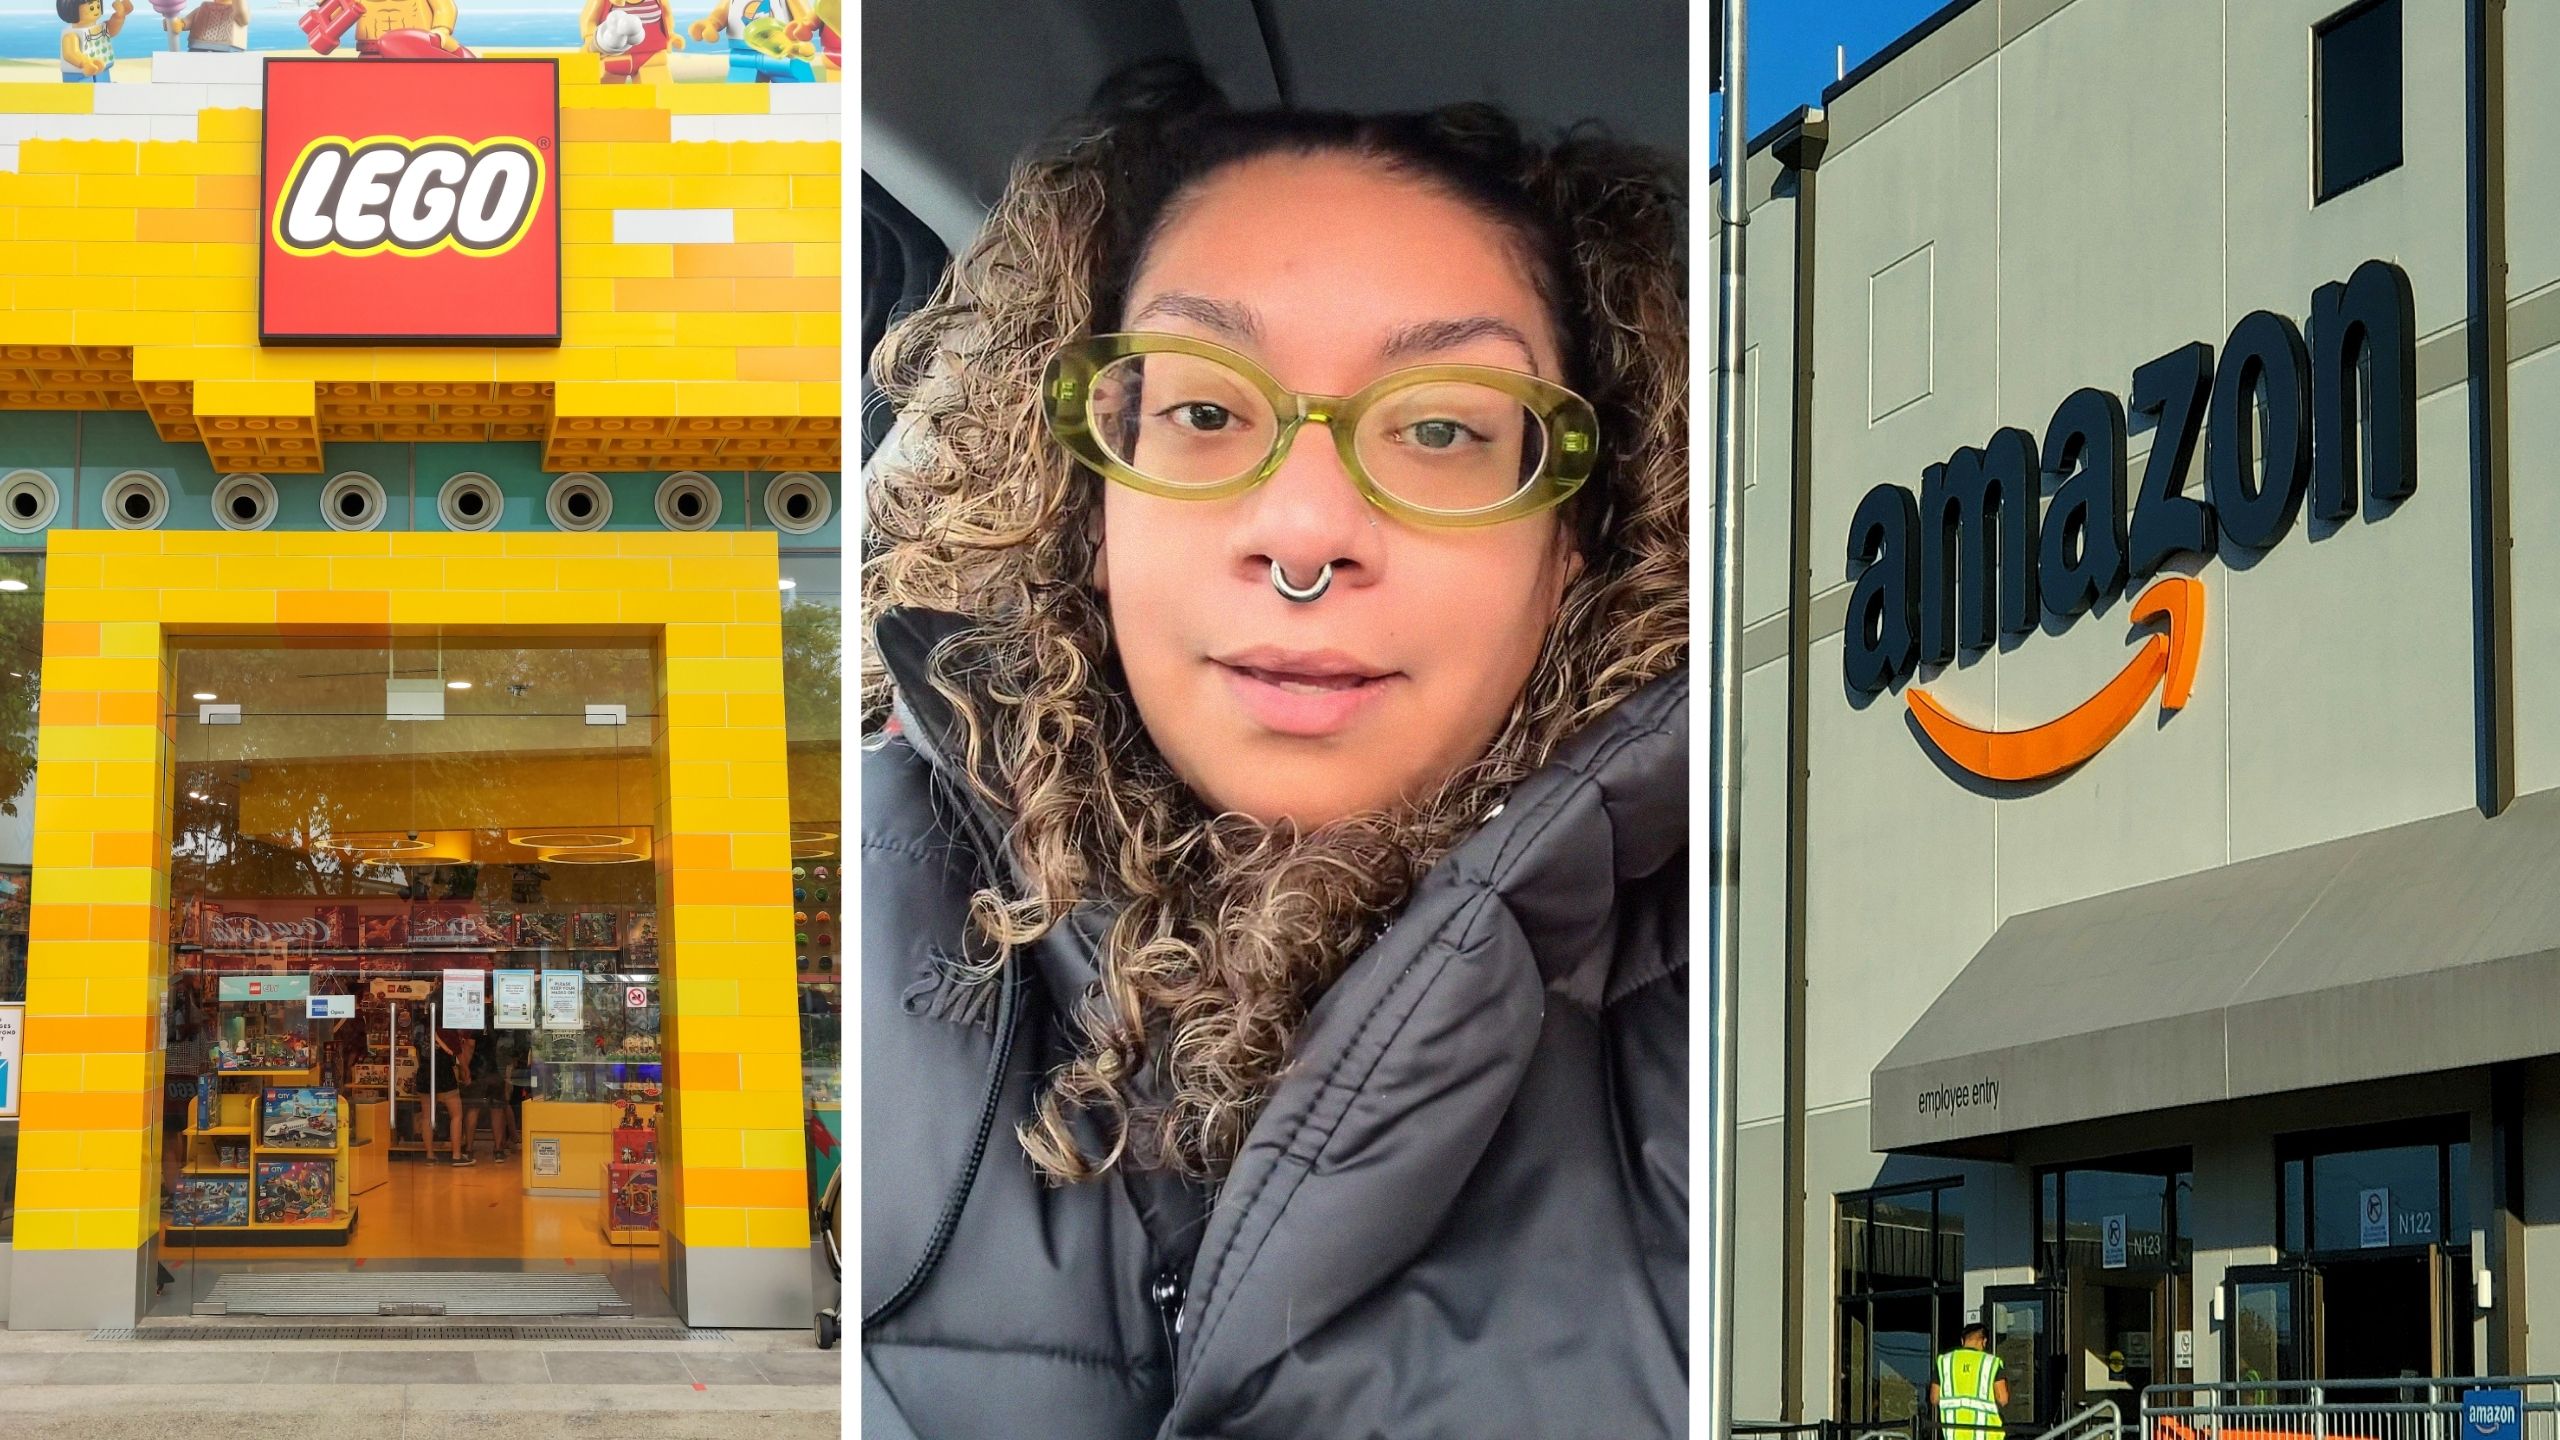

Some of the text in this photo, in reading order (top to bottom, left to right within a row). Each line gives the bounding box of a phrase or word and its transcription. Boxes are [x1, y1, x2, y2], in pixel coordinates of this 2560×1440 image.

[284, 146, 534, 246] LEGO
[1844, 259, 2417, 694] amazon
[1918, 1075, 2000, 1119] employee entry
[2400, 1211, 2431, 1235] N122
[2134, 1235, 2161, 1256] N123
[2469, 1405, 2515, 1424] amazon
